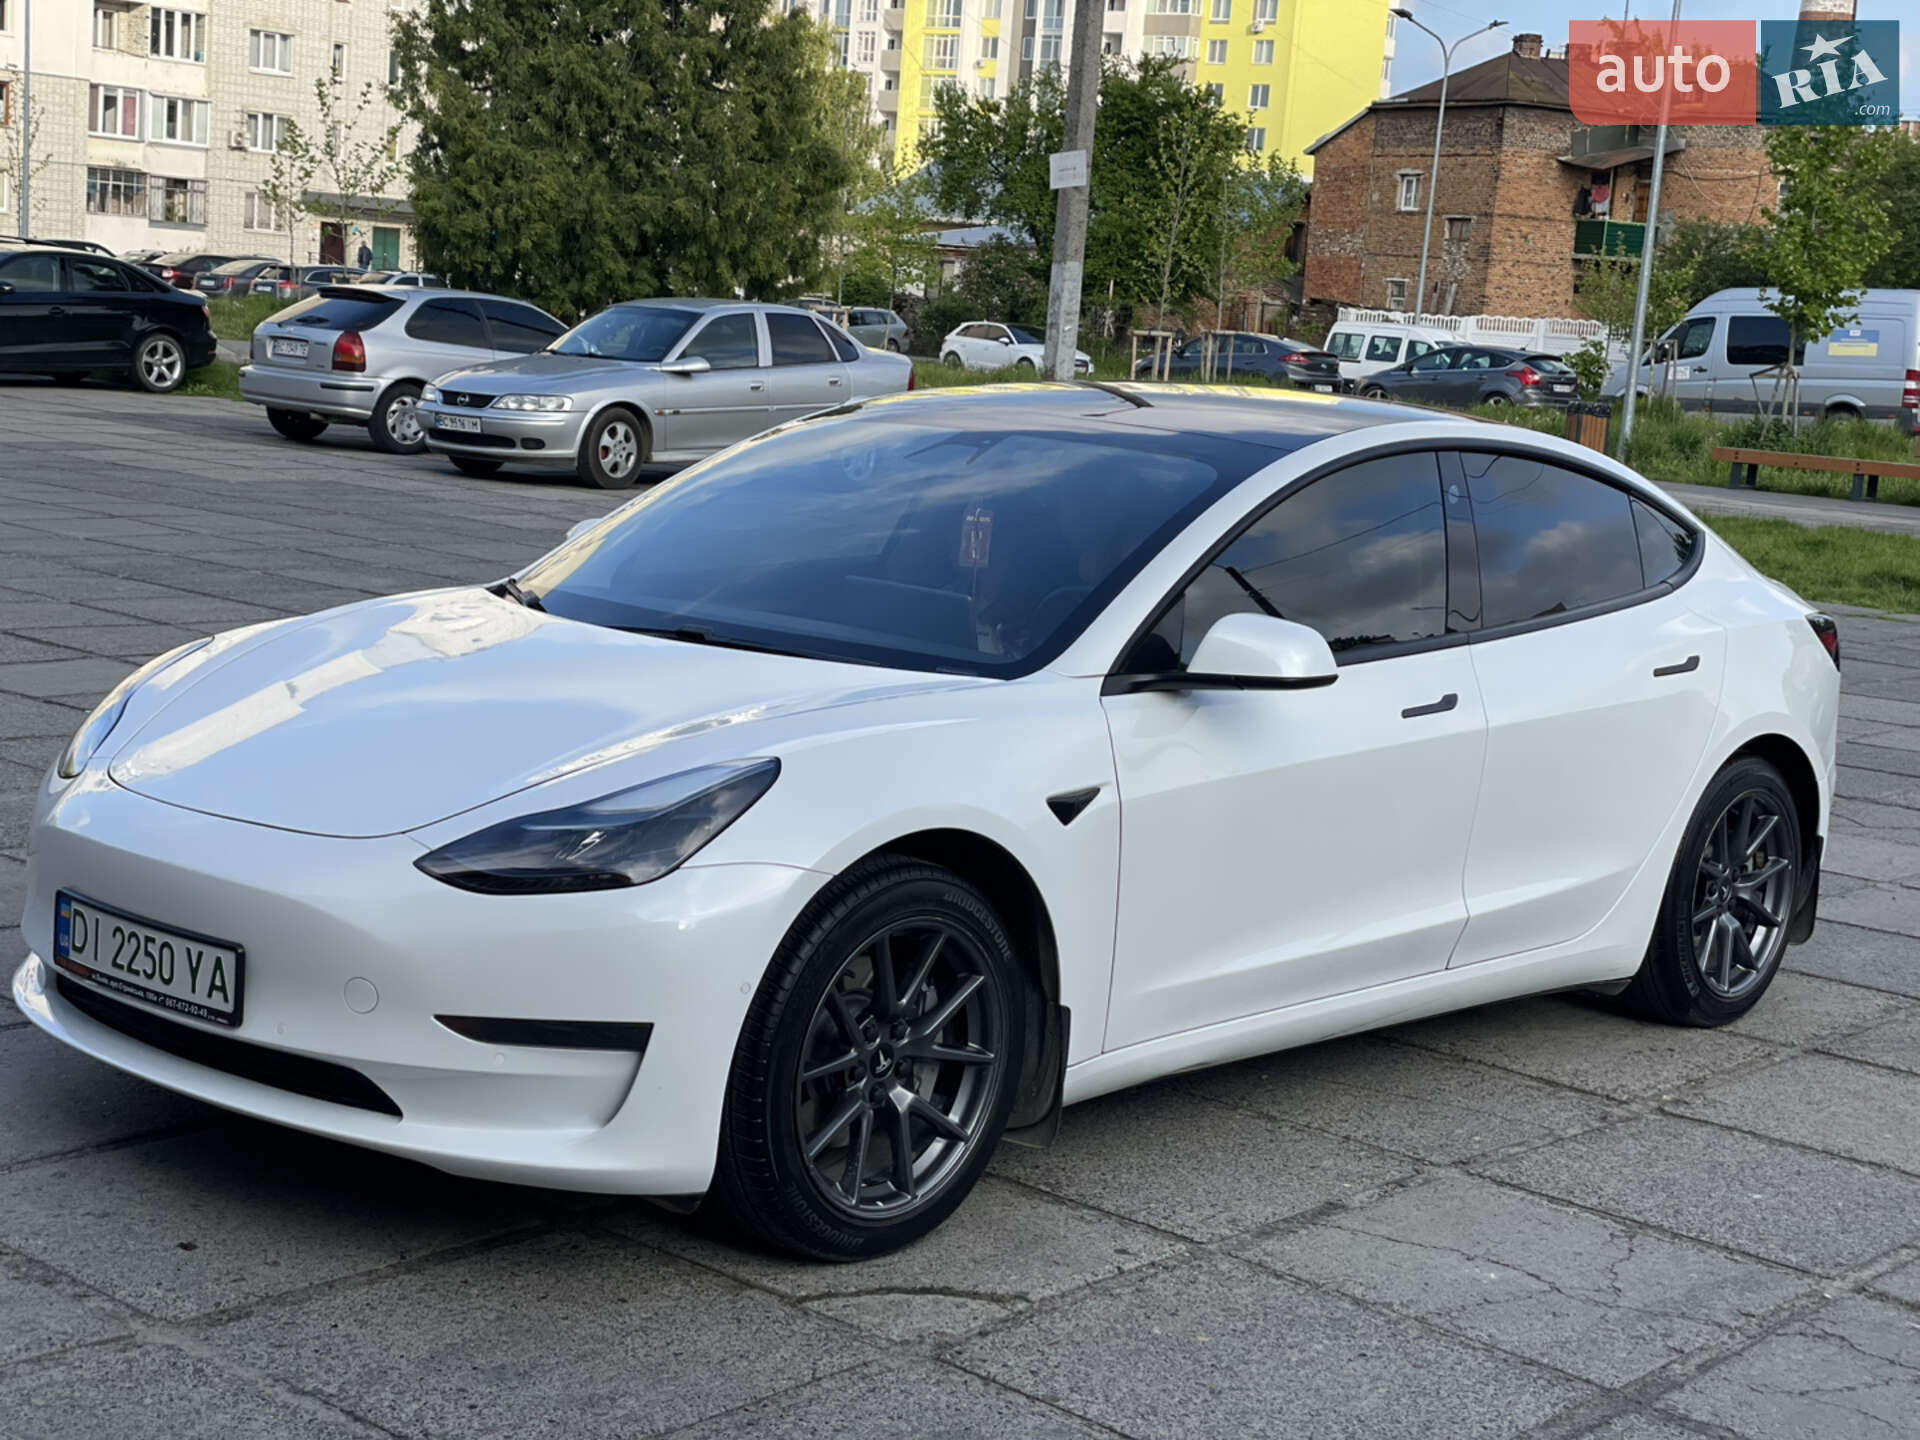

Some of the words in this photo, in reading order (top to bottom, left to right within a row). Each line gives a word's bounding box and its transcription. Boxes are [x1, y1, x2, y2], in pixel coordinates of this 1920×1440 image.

[72, 908, 99, 961] DI
[112, 926, 174, 985] 2250
[186, 947, 229, 1003] YA
